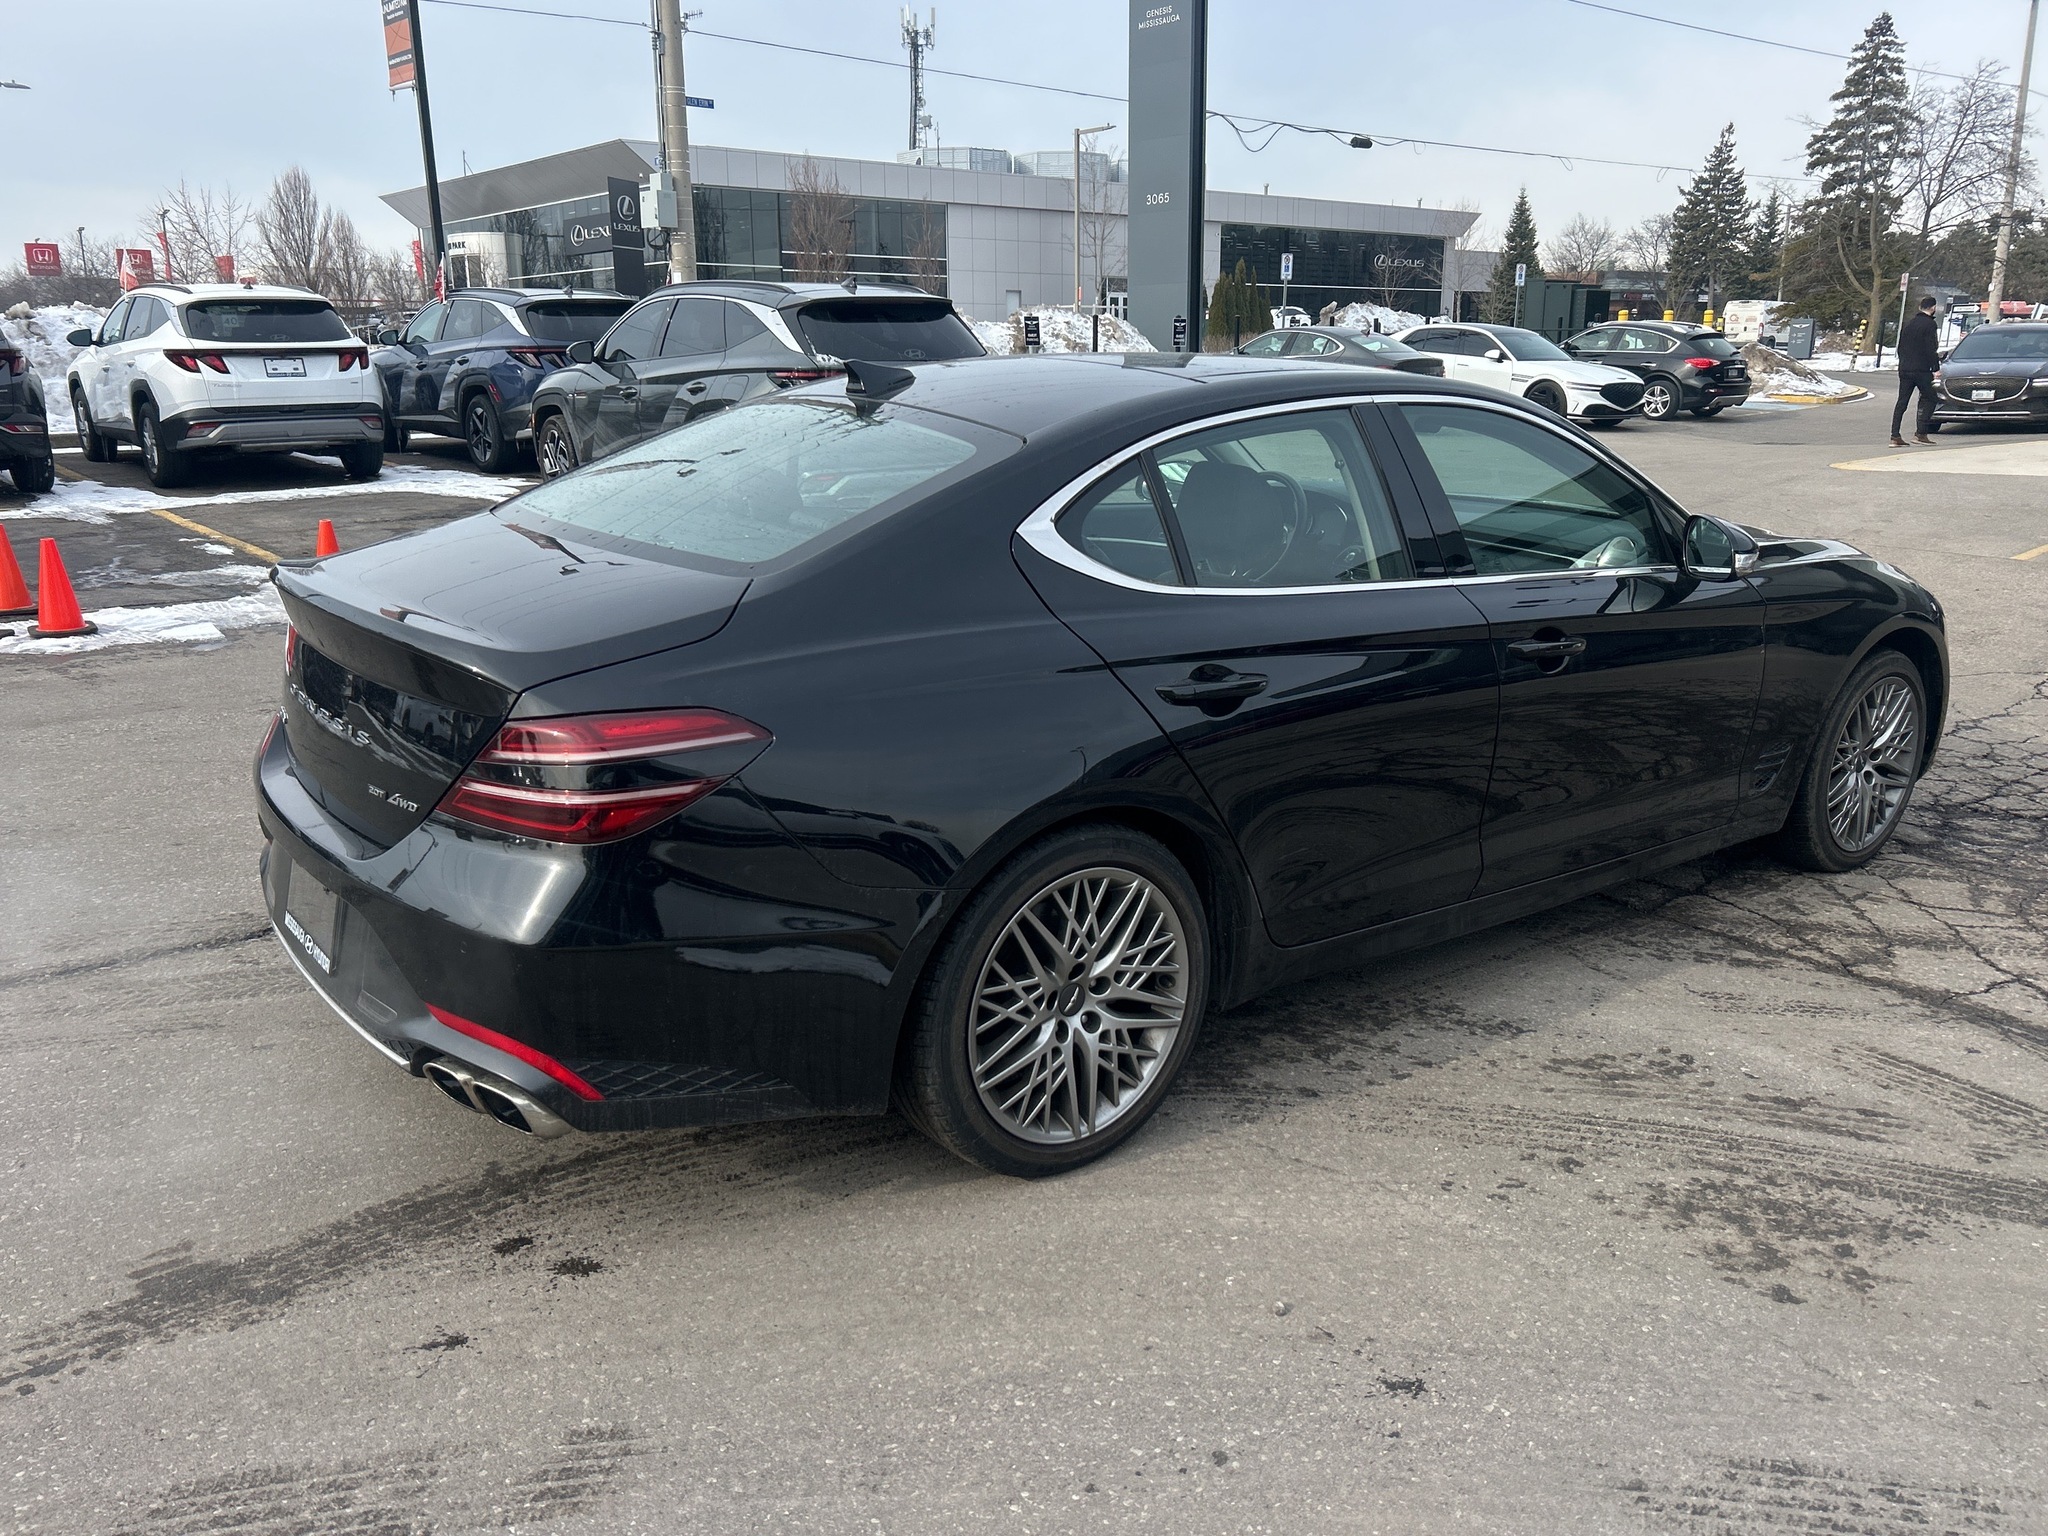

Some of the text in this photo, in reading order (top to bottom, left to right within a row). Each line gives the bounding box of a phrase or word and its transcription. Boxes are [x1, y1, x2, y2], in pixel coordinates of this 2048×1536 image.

[1146, 5, 1172, 18] GENESIS
[1138, 14, 1180, 30] MISSISSAUGA
[1146, 192, 1170, 205] 3065
[584, 225, 612, 239] LEXU
[613, 222, 640, 232] LEXUS
[452, 241, 466, 249] PARK
[1388, 258, 1425, 268] LEXUS
